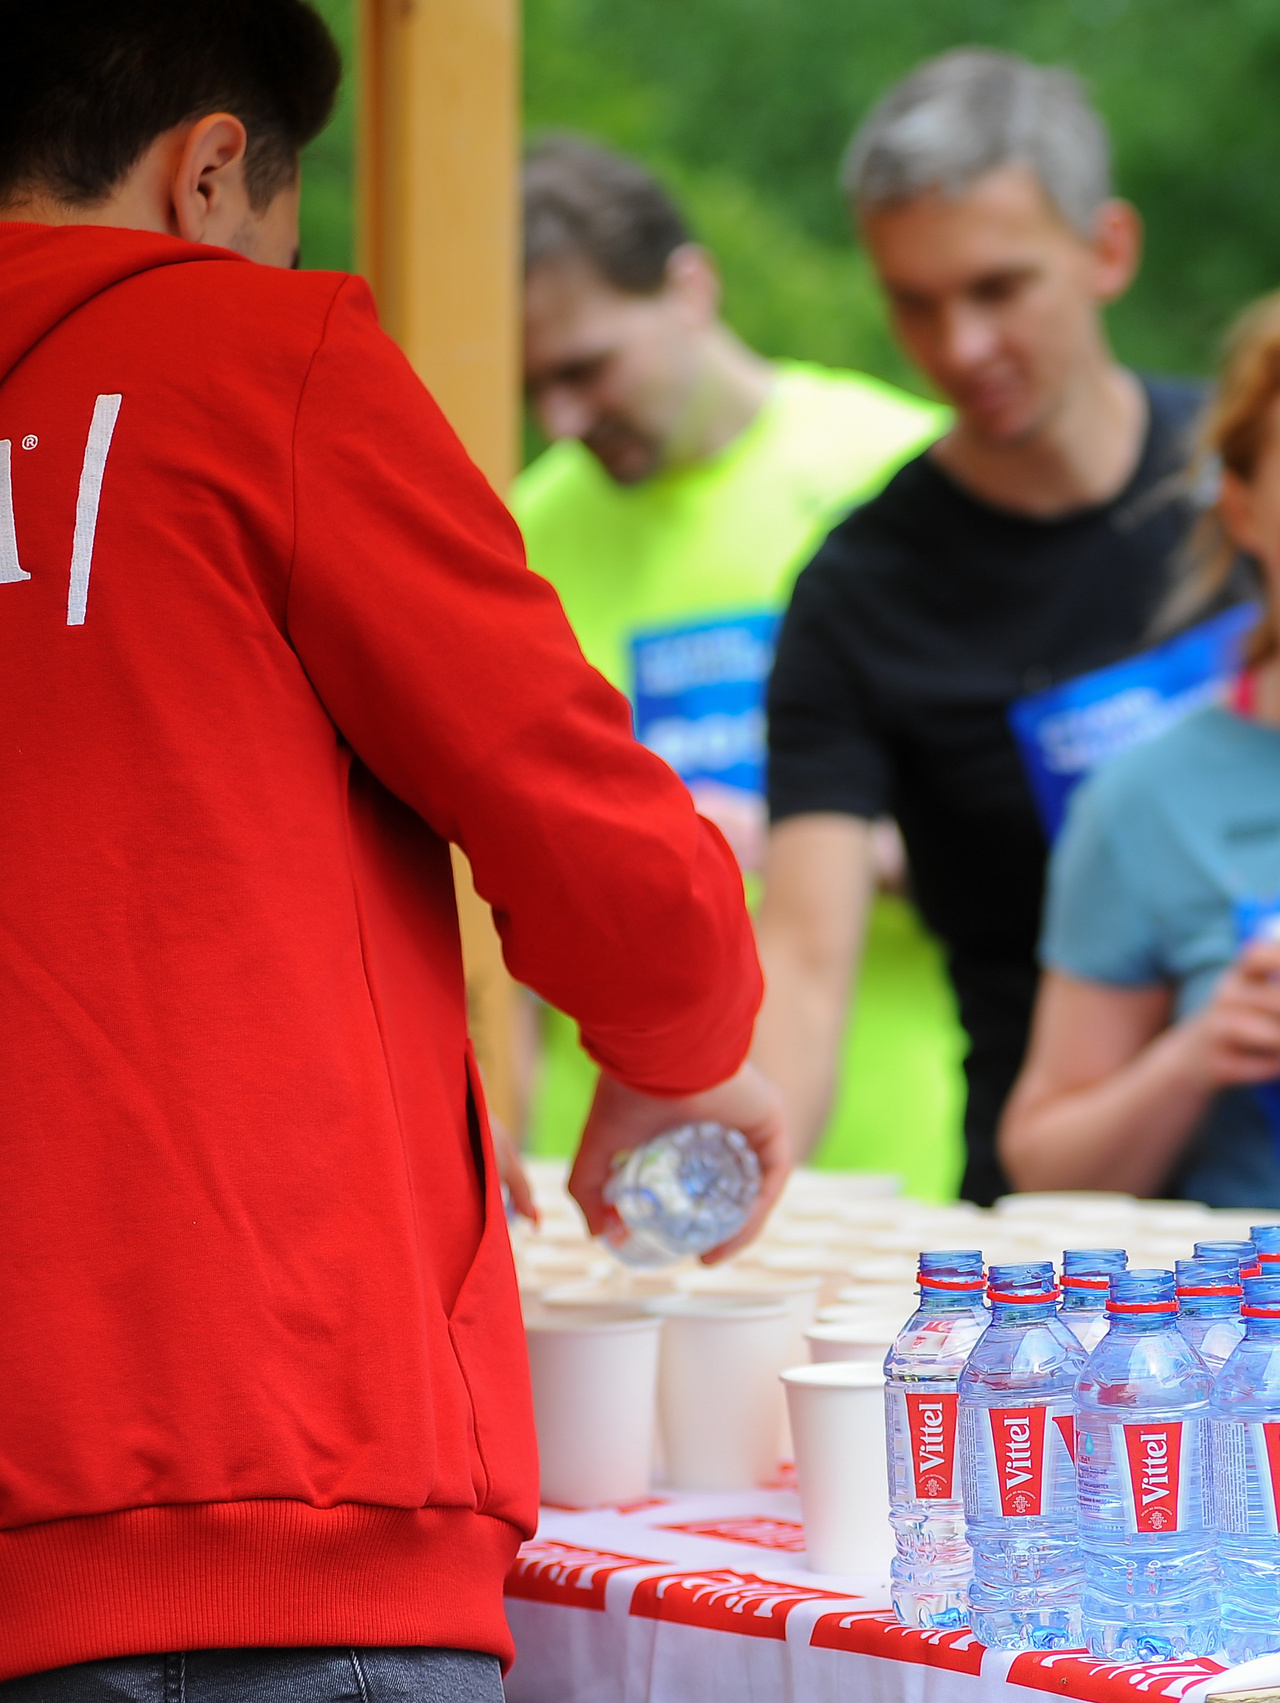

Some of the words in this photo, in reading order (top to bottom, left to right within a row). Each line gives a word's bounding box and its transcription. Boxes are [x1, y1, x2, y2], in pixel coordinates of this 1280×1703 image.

[918, 1401, 943, 1474] Vittel
[1004, 1416, 1033, 1490] Vittel
[1140, 1431, 1169, 1506] Vittel
